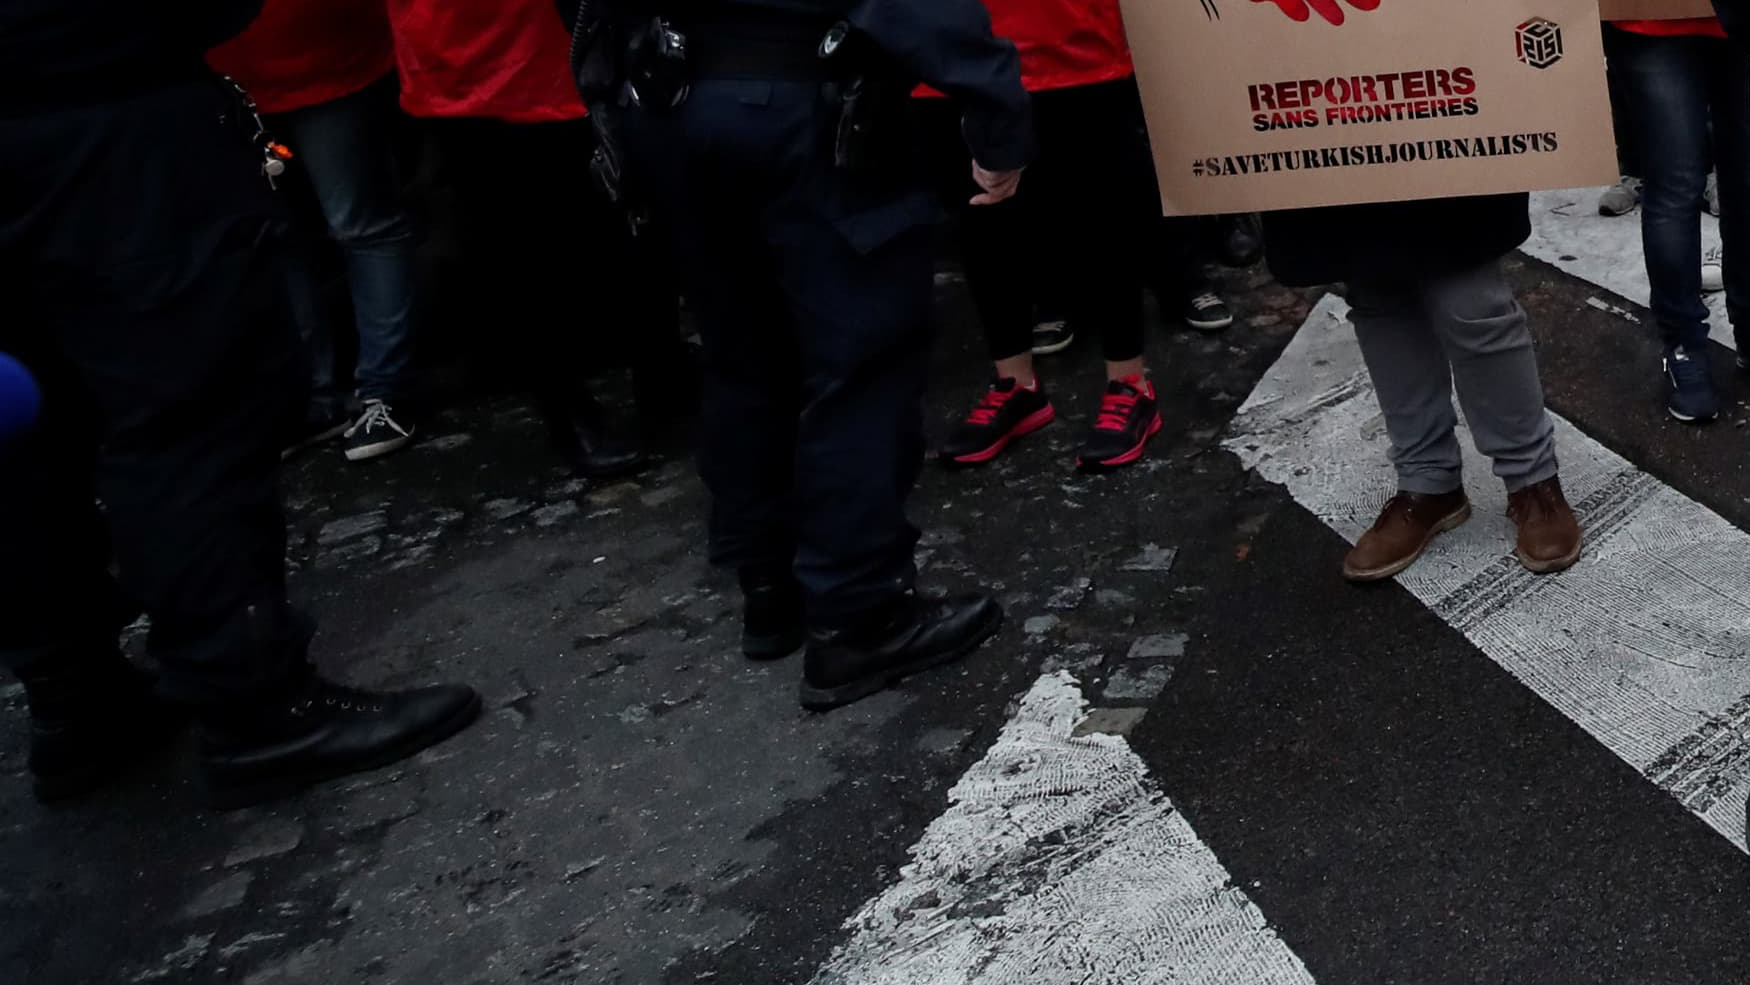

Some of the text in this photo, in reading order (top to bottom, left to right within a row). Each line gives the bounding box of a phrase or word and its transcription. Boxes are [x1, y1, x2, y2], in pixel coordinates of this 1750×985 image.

[1248, 67, 1476, 112] REPORTERS
[1253, 97, 1479, 132] SANS FRONTIERES
[1192, 131, 1558, 177] #SAVETURKISHJOURNALISTS
